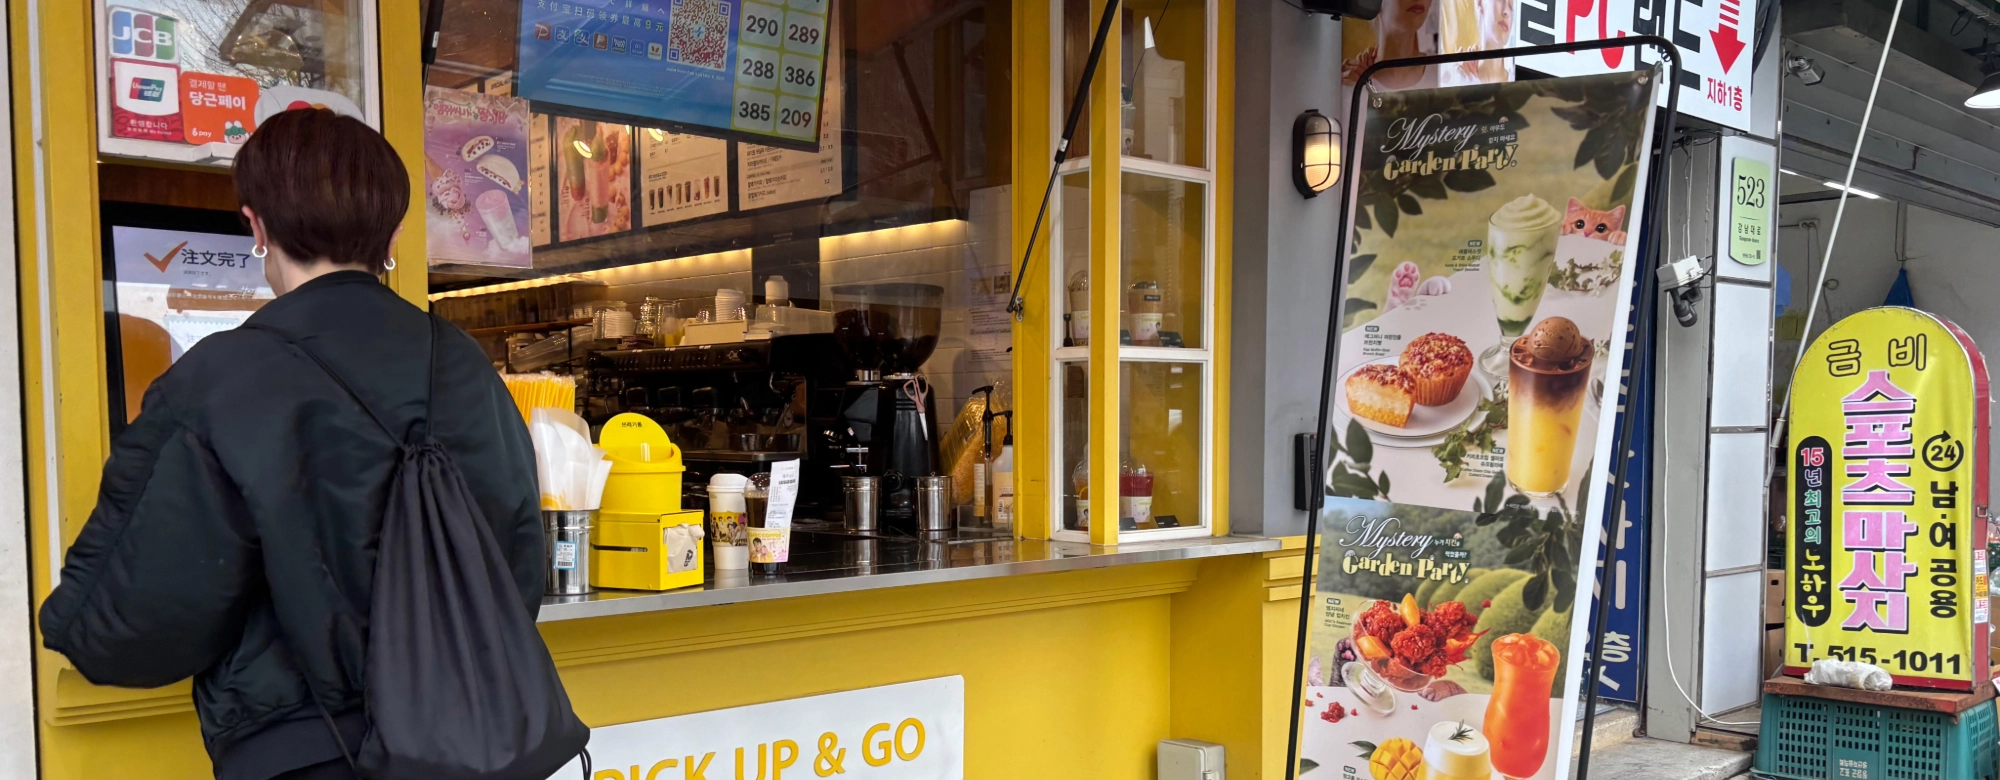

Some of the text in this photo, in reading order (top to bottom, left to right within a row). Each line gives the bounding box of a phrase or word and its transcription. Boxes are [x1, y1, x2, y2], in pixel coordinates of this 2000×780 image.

[112, 25, 173, 46] JCB
[745, 15, 819, 45] 290 289
[132, 82, 163, 92] UnionPay
[189, 79, 215, 90] 결제할
[742, 58, 774, 80] 288
[784, 65, 815, 87] 386
[189, 91, 246, 111] 당근페이
[1707, 77, 1743, 112] 지하1층
[739, 100, 812, 128] 385 209
[1380, 113, 1479, 160] Mystery
[1383, 144, 1519, 180] Garden Party
[1737, 174, 1765, 208] 523
[181, 249, 251, 268] 注文完了
[1930, 444, 1957, 462] 24
[1838, 368, 1919, 634] 스포츠마사지
[1339, 515, 1434, 559] Mystery
[1342, 553, 1470, 584] Garden Party
[1800, 548, 1827, 619] 노하우
[1929, 558, 1958, 619] 공용
[1827, 645, 1960, 675] 515-1011
[735, 739, 799, 780] UP
[813, 731, 847, 777] &
[861, 717, 926, 767] GO
